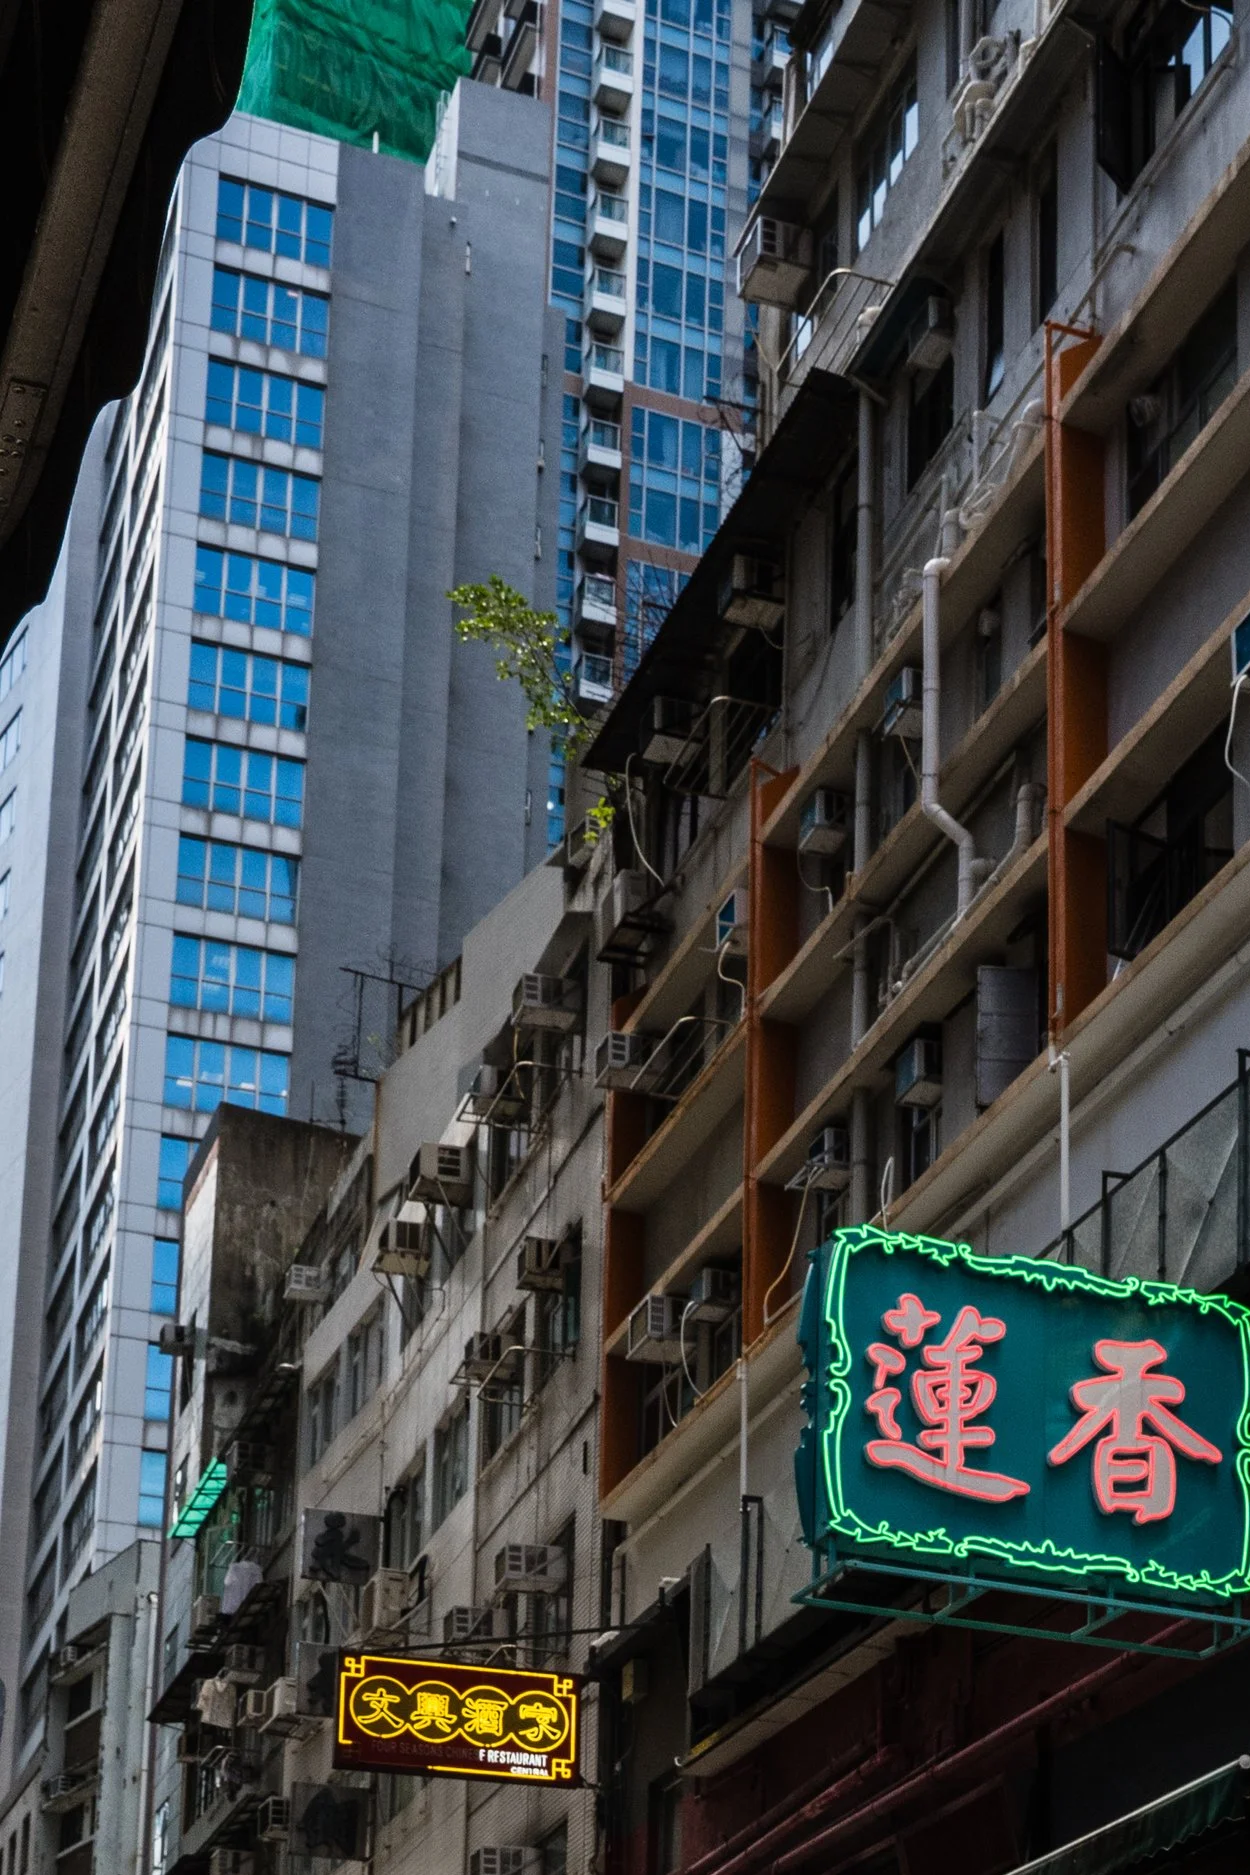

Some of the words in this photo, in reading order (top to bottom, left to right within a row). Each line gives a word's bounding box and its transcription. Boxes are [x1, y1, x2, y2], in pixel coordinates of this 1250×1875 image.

[865, 1293, 1223, 1526] 蓮香
[357, 1687, 562, 1742] 文興酒家
[488, 1749, 549, 1768] RESTAURANT
